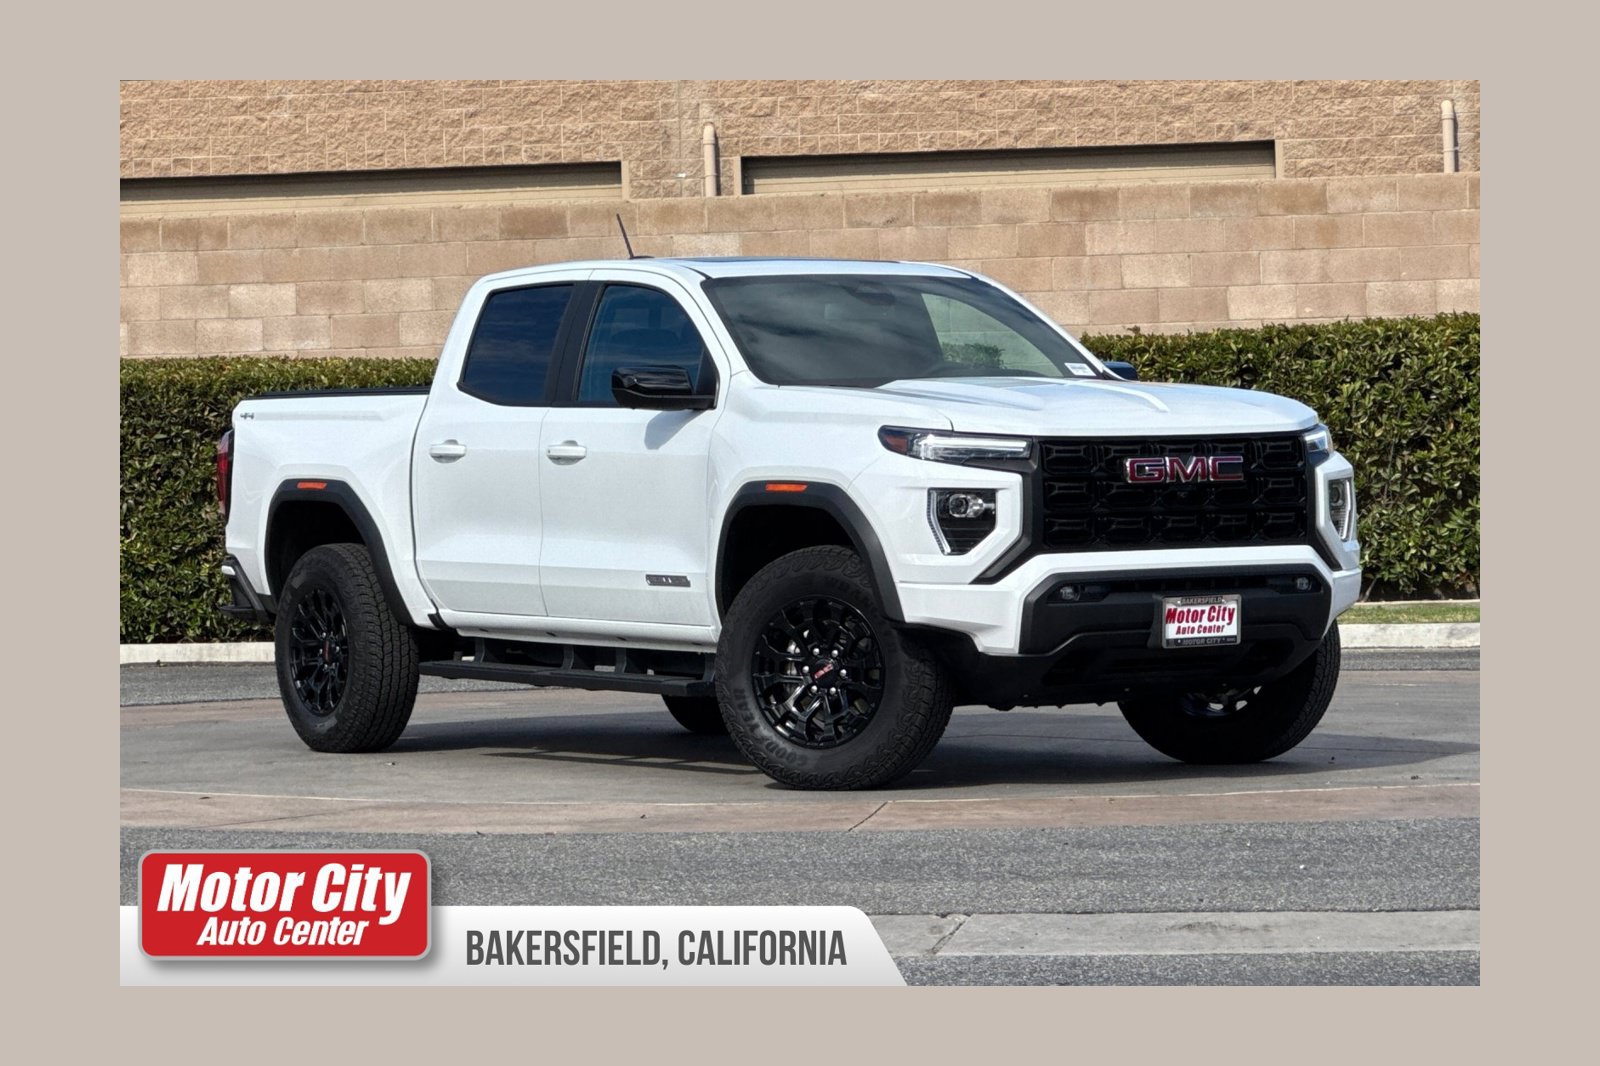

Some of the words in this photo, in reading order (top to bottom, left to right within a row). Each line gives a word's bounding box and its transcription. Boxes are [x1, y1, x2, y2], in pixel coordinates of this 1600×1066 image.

[1126, 456, 1244, 483] GMC
[1181, 596, 1221, 605] BAKERSFIELD
[1165, 608, 1205, 624] Motor
[1207, 605, 1235, 625] City
[1176, 626, 1195, 635] Auto
[1197, 624, 1225, 634] Center
[1182, 638, 1205, 646] MOTOR
